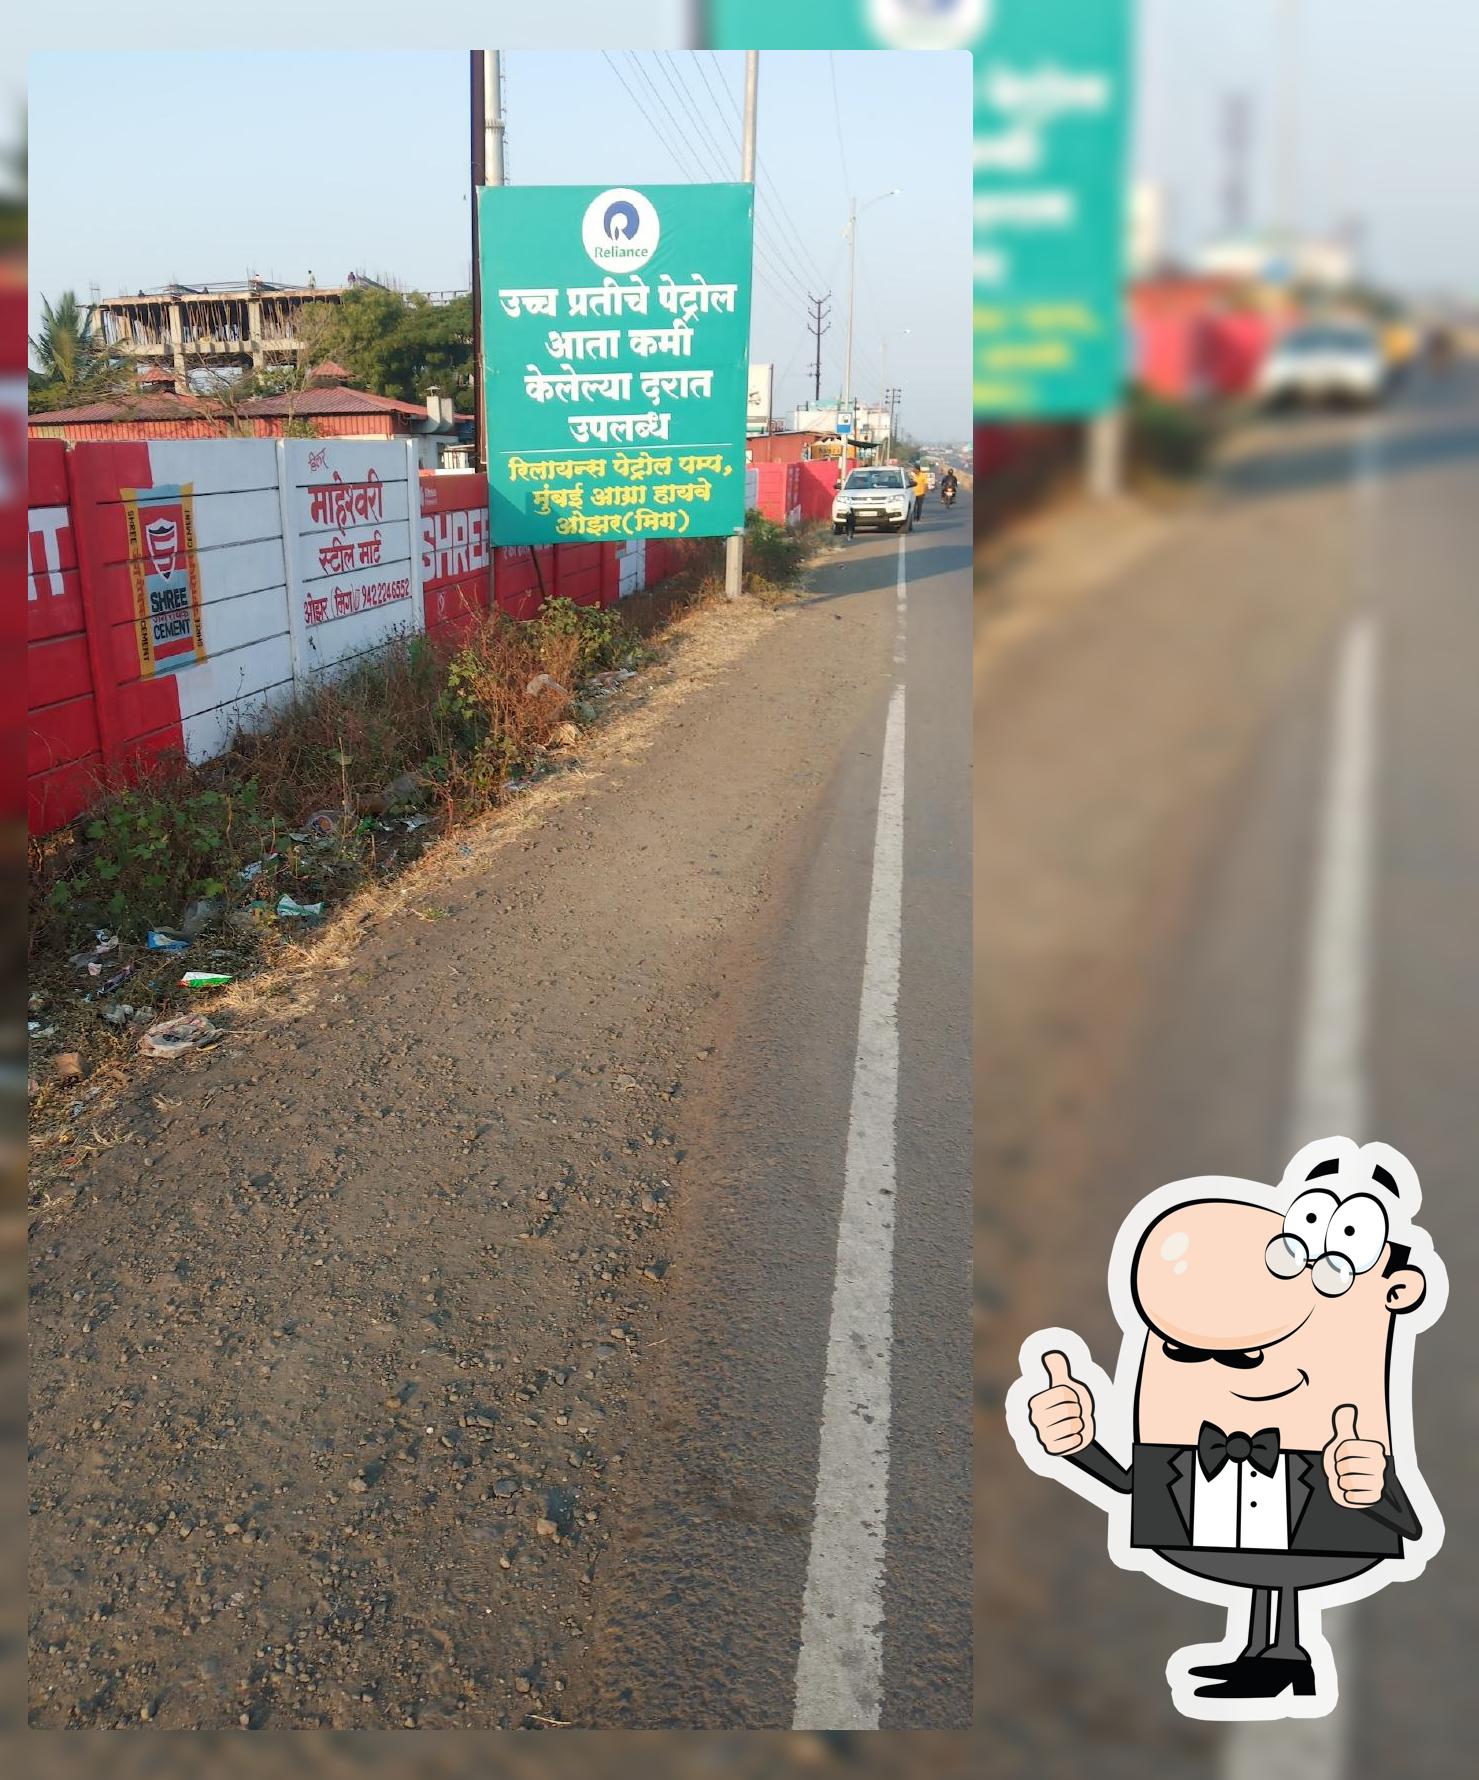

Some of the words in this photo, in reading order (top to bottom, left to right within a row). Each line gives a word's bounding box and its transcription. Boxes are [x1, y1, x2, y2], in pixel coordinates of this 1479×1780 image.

[594, 246, 649, 259] Reliance
[499, 288, 558, 318] उच्च
[566, 276, 650, 317] प्रतीचे
[658, 273, 738, 322] पेट्रोल
[545, 329, 621, 360] आता
[628, 318, 695, 357] कमी
[523, 364, 633, 403] केलेल्या
[639, 369, 714, 406] दरात
[567, 411, 671, 443] उपलब्ध
[508, 456, 606, 482] रिलायन्स
[612, 452, 672, 482] पेट्रोल
[533, 483, 584, 515] मुंबई
[590, 485, 646, 508] आग्रा
[652, 477, 712, 503] हायवे
[318, 536, 355, 576] स्टील
[357, 530, 382, 564] मार्ट
[150, 587, 188, 613] SHREE
[140, 619, 150, 662] CEMENT
[153, 618, 191, 640] CEMENT
